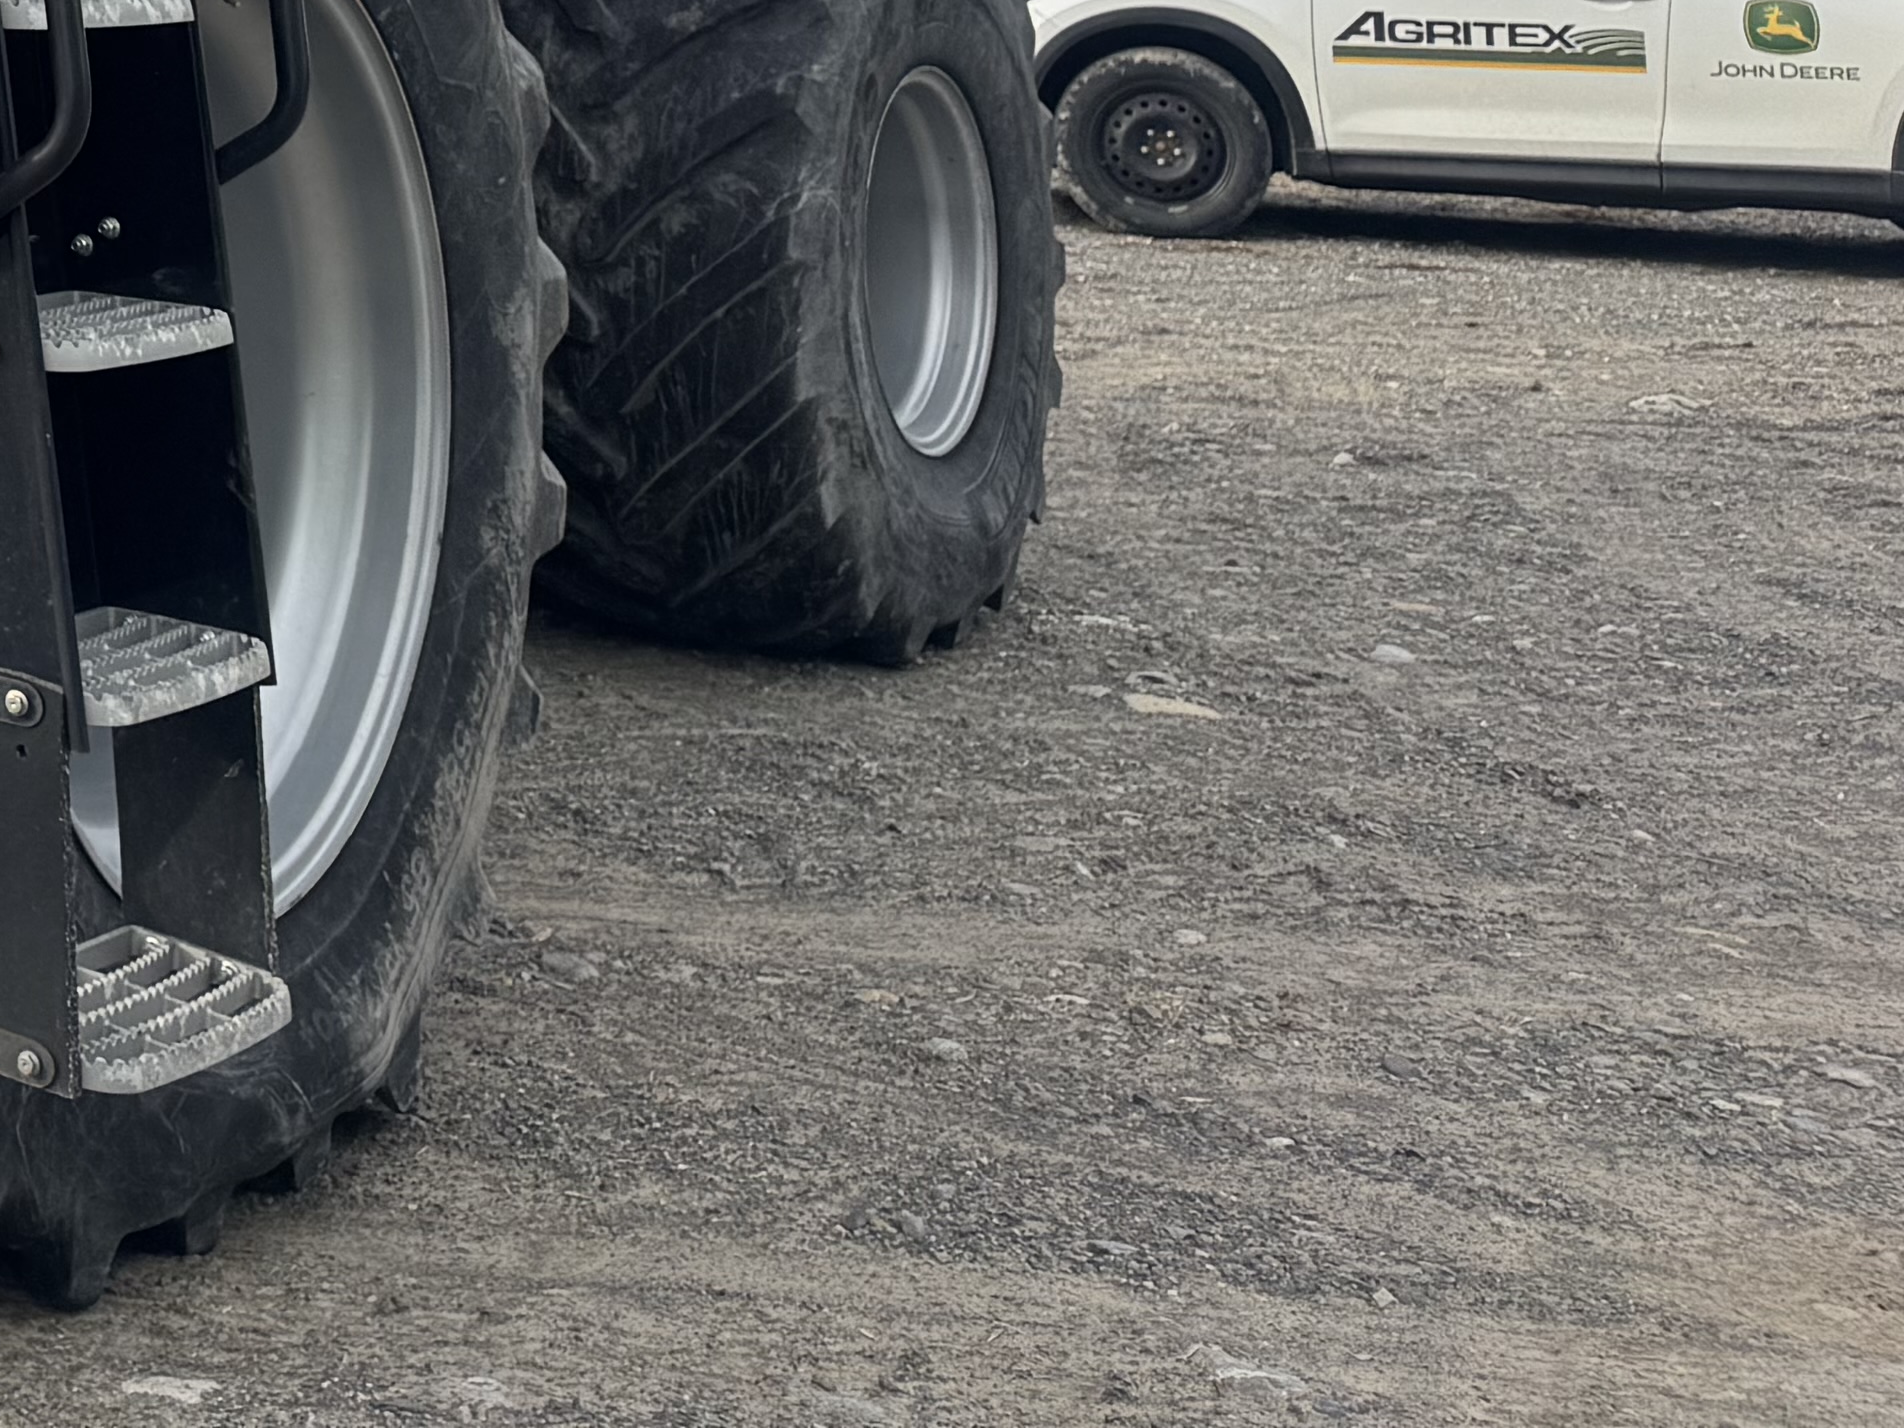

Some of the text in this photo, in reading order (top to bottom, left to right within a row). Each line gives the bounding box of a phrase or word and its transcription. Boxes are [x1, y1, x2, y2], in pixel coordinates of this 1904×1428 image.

[1334, 10, 1577, 49] AGRITEX
[1710, 61, 1861, 82] JOHN DEERE
